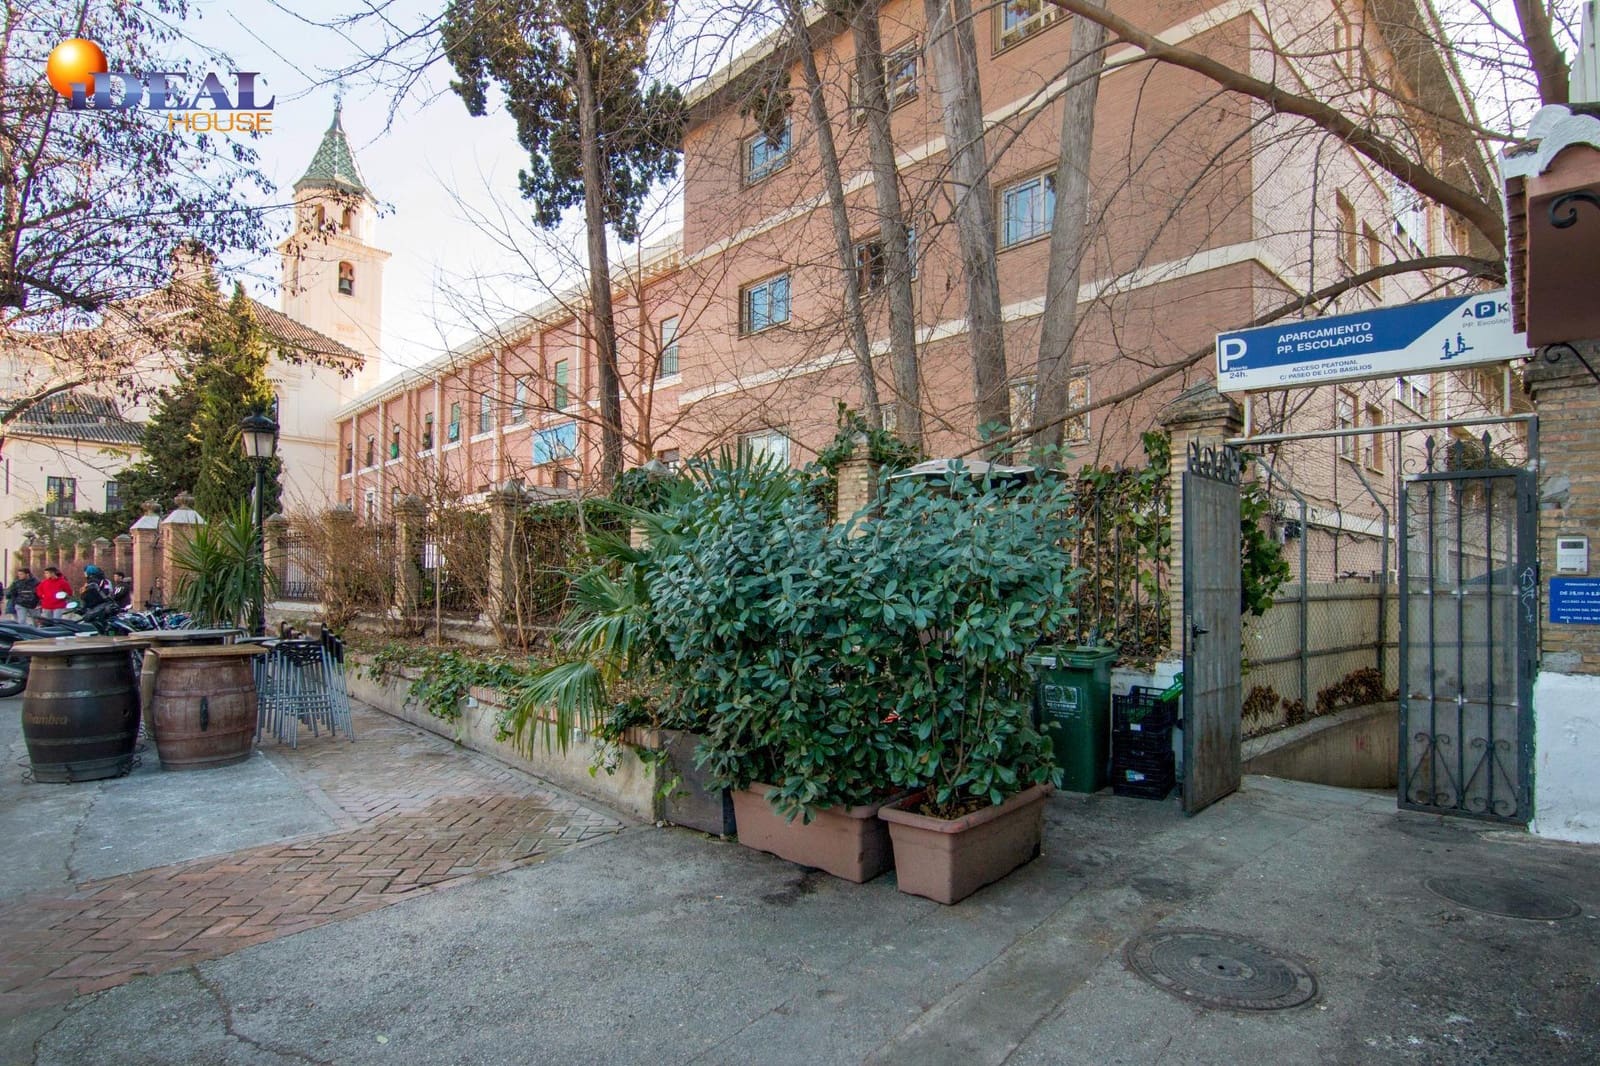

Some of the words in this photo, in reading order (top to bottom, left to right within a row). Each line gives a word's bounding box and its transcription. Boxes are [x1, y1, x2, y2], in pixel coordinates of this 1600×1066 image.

[1276, 345, 1294, 354] PP.
[1297, 333, 1373, 352] ESCOLAPIOS
[1278, 322, 1371, 344] APARCAMIENTO
[1220, 338, 1248, 371] P
[1288, 371, 1311, 379] PASEO
[1339, 364, 1372, 373] BASILIOS
[1292, 364, 1320, 372] ACCESO
[1321, 360, 1357, 369] PEATONAL
